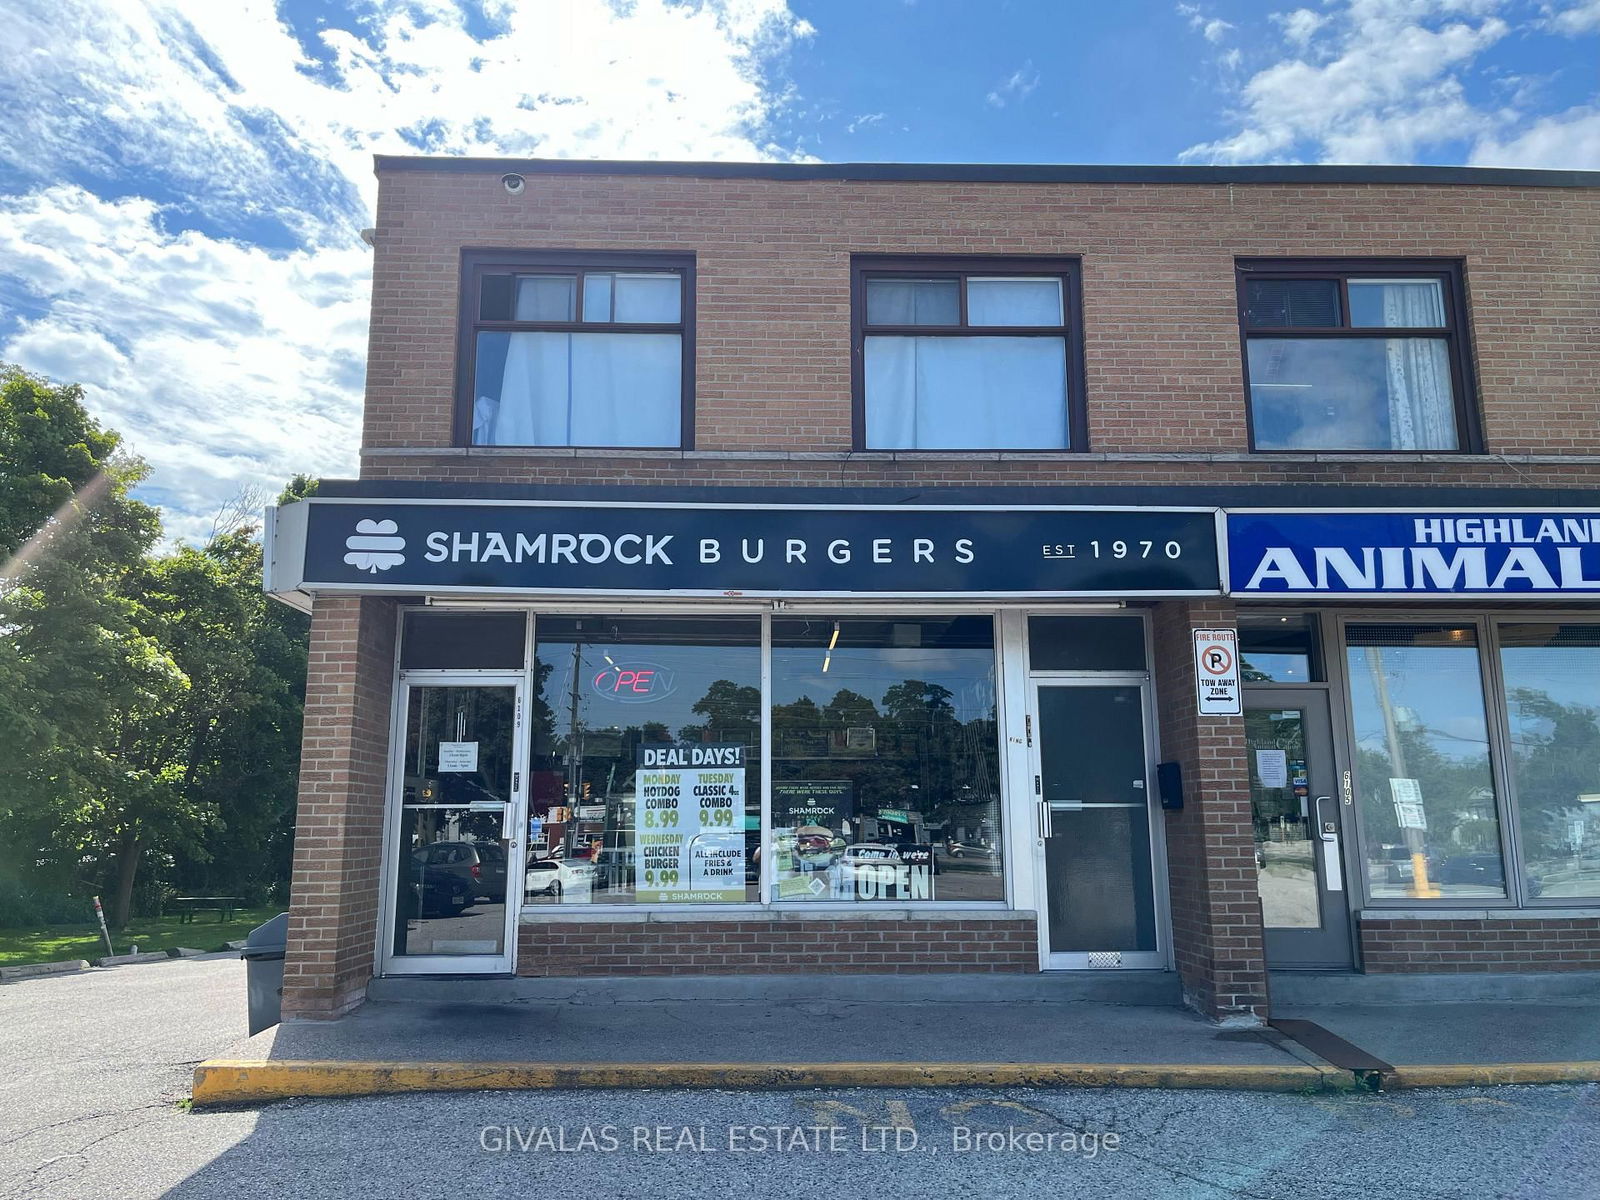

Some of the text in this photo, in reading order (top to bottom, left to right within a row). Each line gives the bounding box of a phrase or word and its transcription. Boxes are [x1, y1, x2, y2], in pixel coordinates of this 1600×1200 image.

[1414, 518, 1600, 543] HIGHLAN
[424, 531, 1182, 565] SHAMROCK BURGERS EST 1970
[1244, 547, 1600, 589] ANIMAL
[1212, 633, 1235, 641] ROUTE
[595, 670, 676, 693] OPEN
[1217, 679, 1236, 687] AWAY
[1210, 687, 1228, 695] ZONE
[644, 747, 741, 766] DEAL DAYS!
[643, 774, 681, 785] MONDAY
[697, 773, 734, 784] TUESDAY
[643, 785, 681, 797] HOTDOG
[693, 785, 726, 796] CLASSIC
[1343, 771, 1352, 804] 6105
[645, 798, 679, 809] COMBO
[699, 797, 733, 808] COMBO
[788, 807, 835, 815] SHAMROCK
[644, 810, 679, 828] 8.99
[699, 809, 734, 828] 9.99
[640, 834, 684, 845] WEDNESDAY
[643, 846, 680, 857] CHICKEN
[858, 848, 884, 859] Come
[644, 858, 679, 869] BURGER
[704, 859, 732, 867] FRIES &
[703, 868, 734, 876] A DRINK
[644, 870, 679, 888] 9.99
[858, 864, 929, 900] OPEN
[672, 892, 723, 900] SHAMROCK
